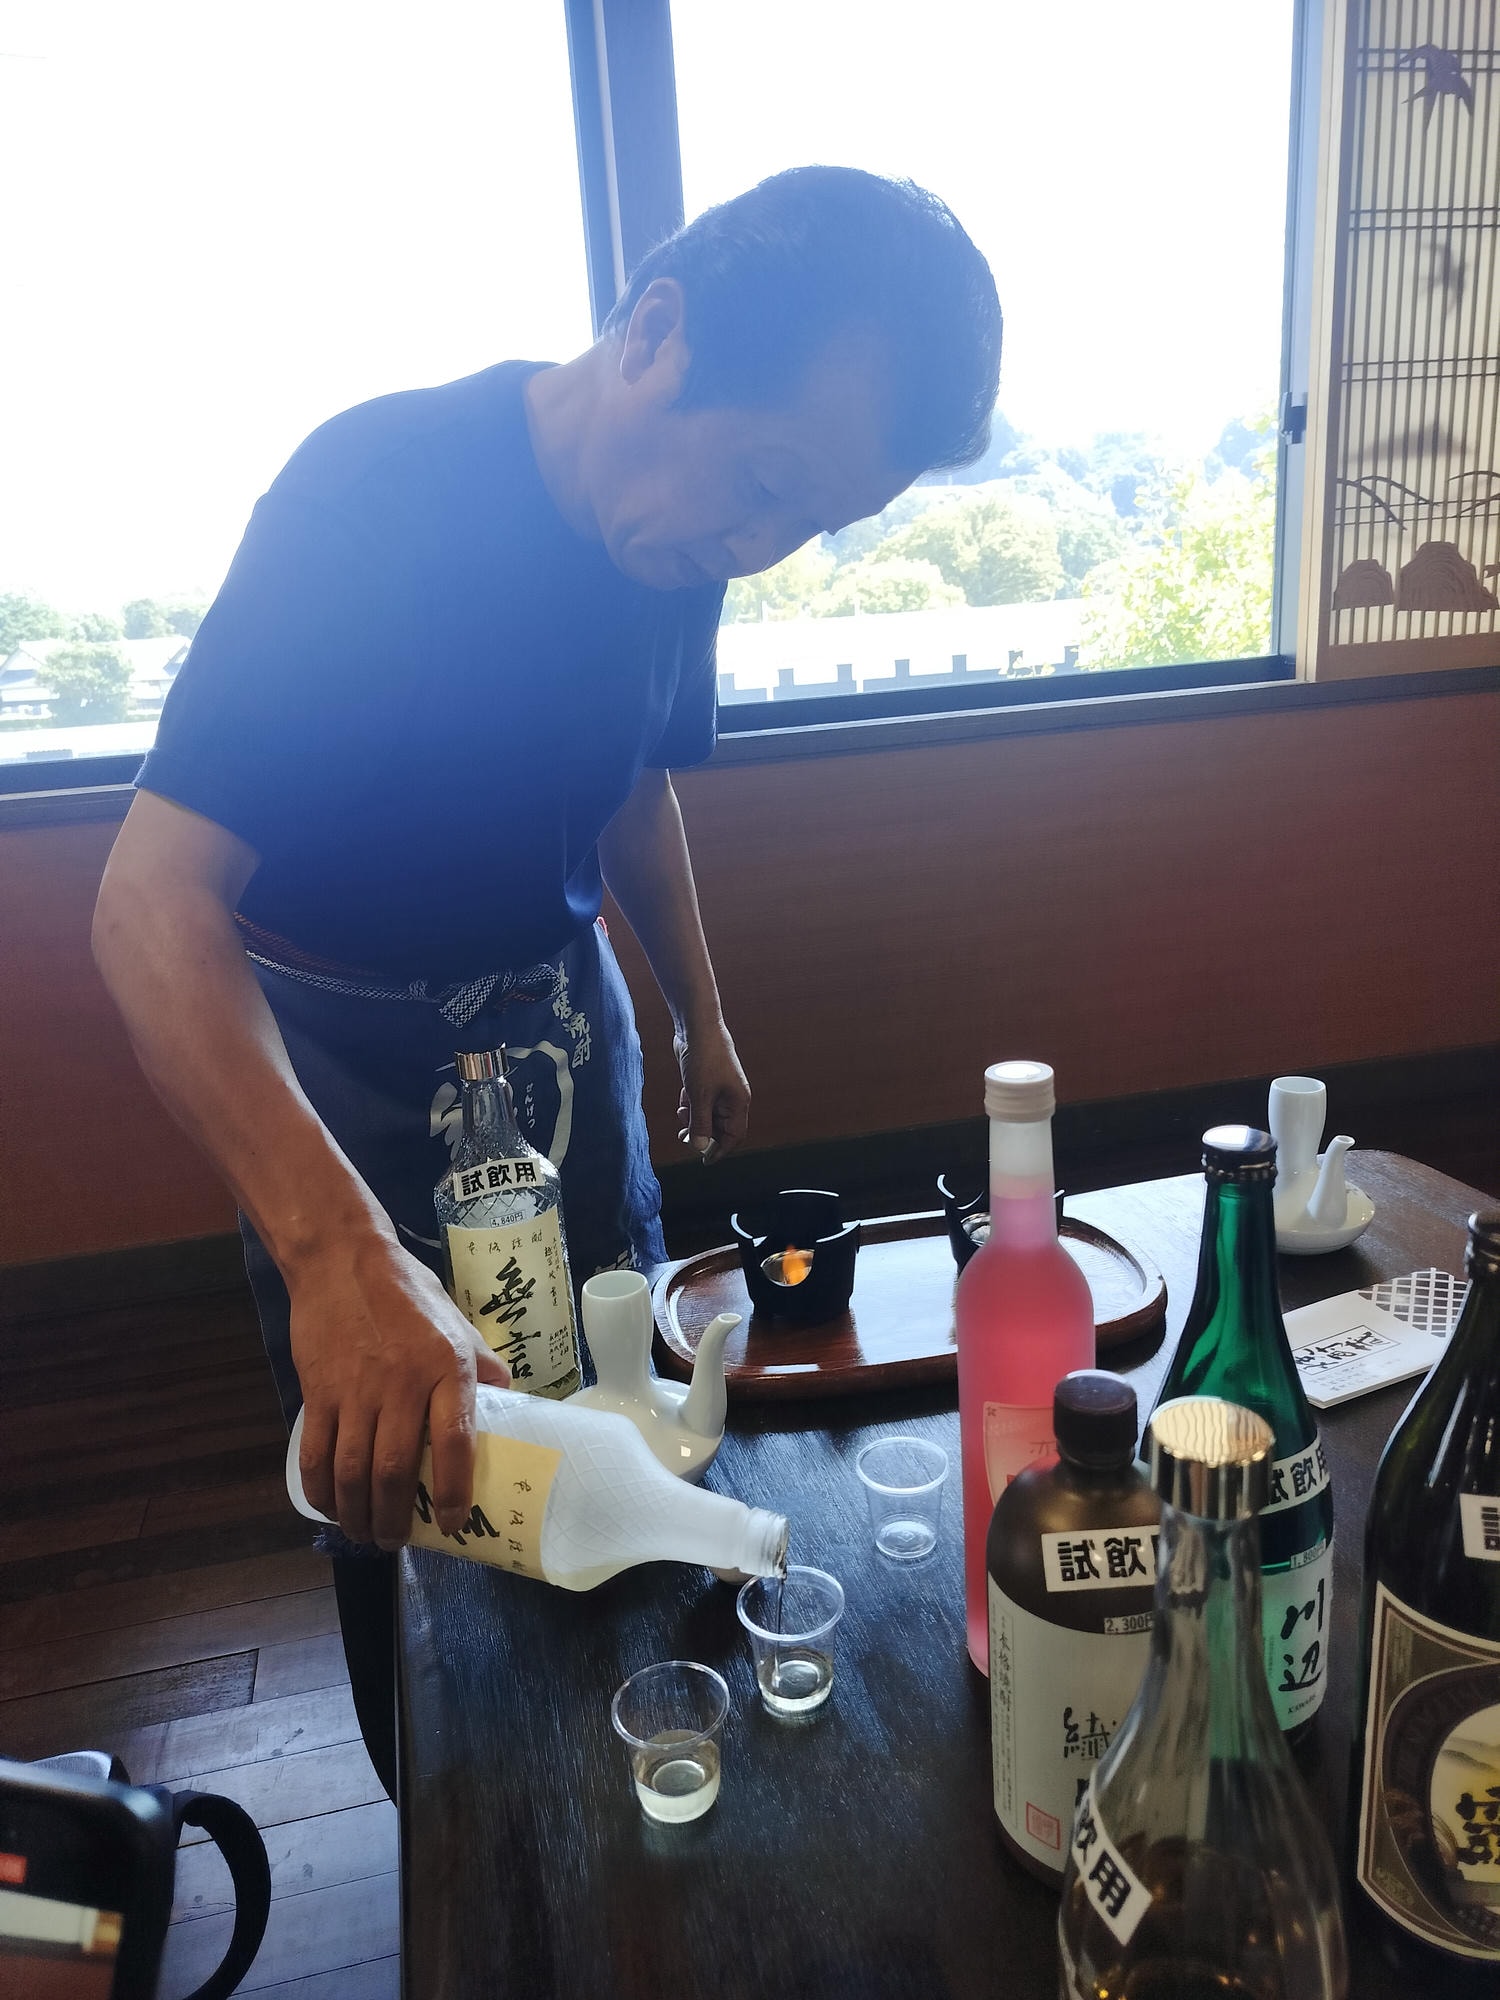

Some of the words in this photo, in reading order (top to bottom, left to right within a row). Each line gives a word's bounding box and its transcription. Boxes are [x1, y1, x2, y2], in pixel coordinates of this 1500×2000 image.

[525, 1083, 535, 1128] せんげつ
[461, 1162, 536, 1197] 試飲用
[1278, 1578, 1325, 1692] 川辺
